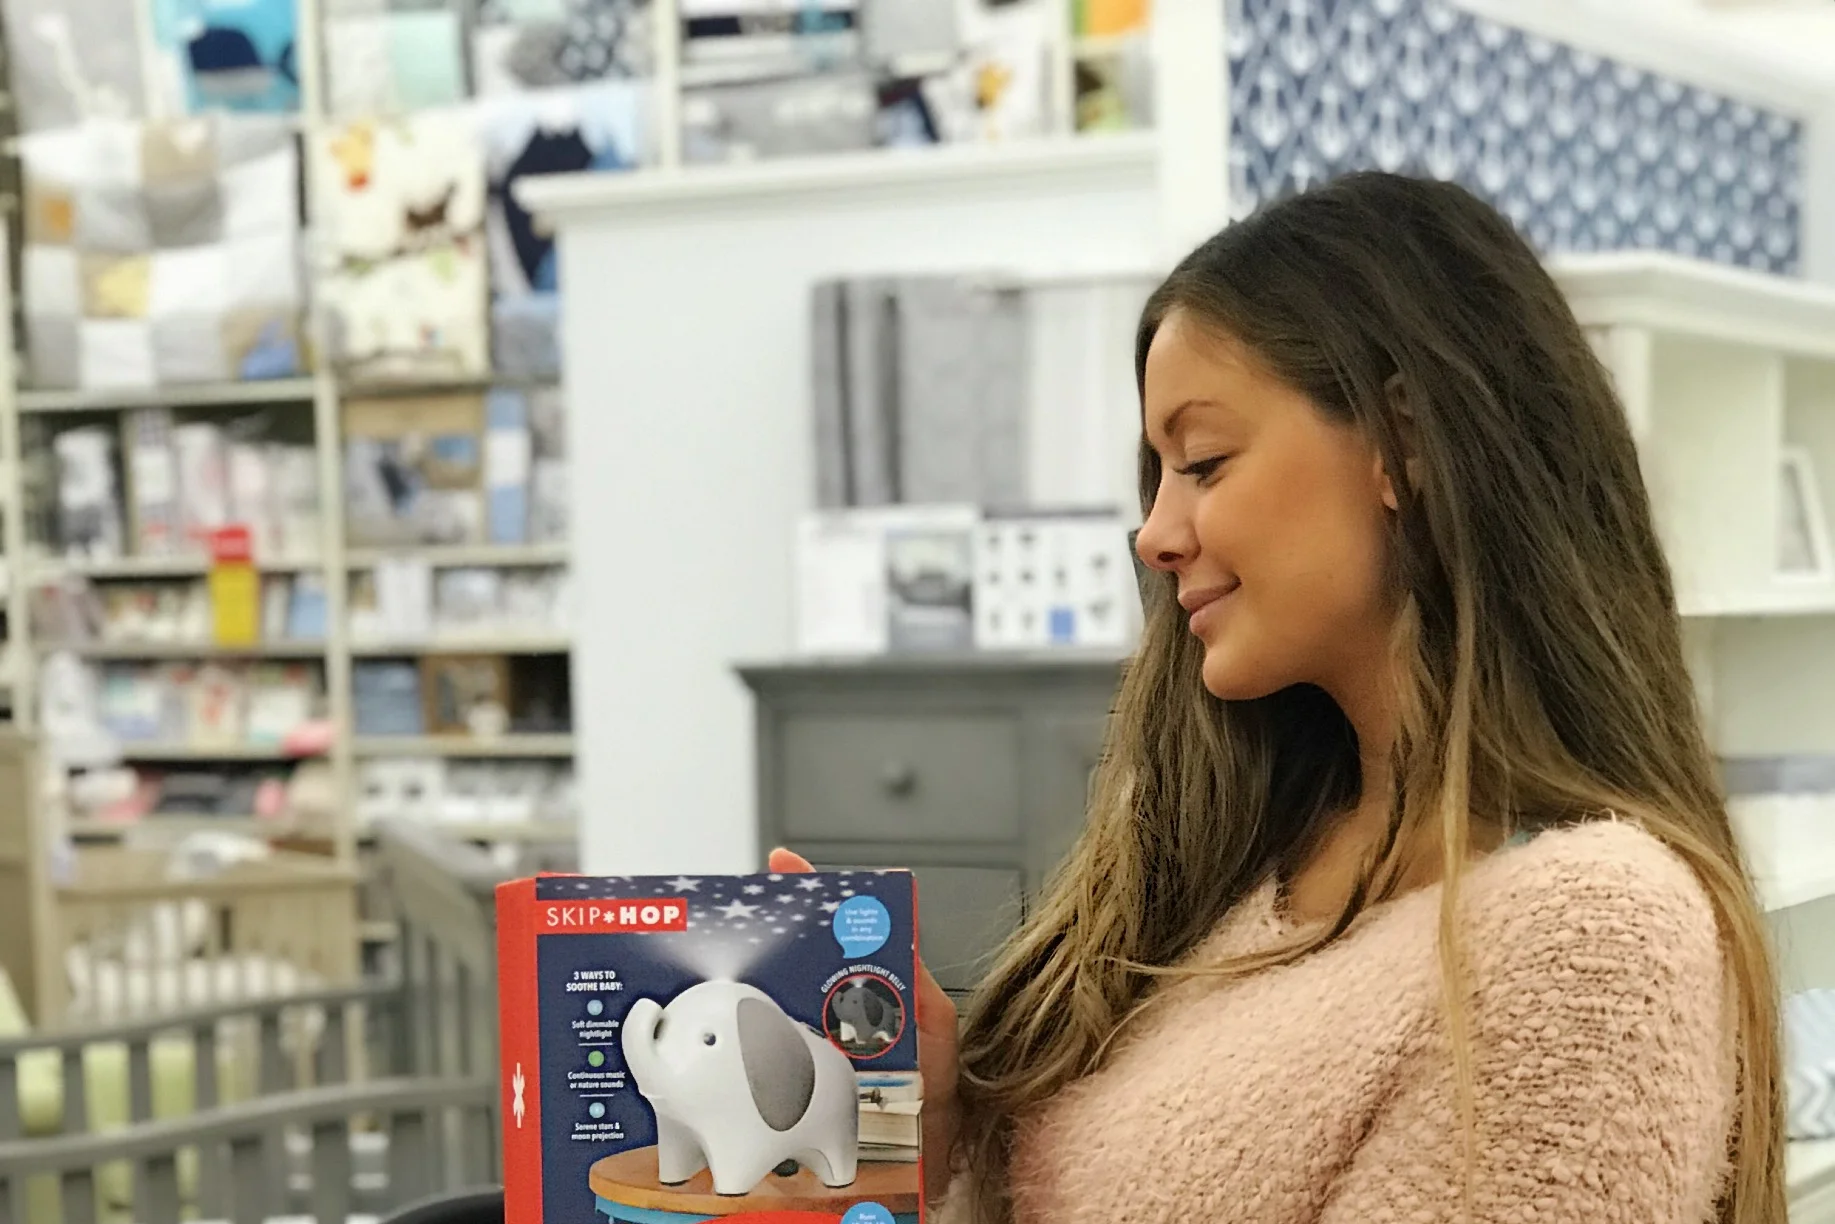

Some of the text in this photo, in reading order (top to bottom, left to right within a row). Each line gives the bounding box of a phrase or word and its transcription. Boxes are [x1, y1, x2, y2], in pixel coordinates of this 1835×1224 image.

[573, 970, 616, 980] 3 WAYS TO
[821, 964, 906, 993] GLOWING NIGHTLIGHT BELLY
[566, 982, 623, 992] SOOTHE BABY:
[571, 1019, 619, 1029] Soft dimmable
[579, 1030, 612, 1040] nightlight
[567, 1070, 625, 1080] Continuous music
[600, 1080, 624, 1088] sounds
[574, 1122, 598, 1131] Serene
[598, 1122, 614, 1130] stars
[591, 1132, 624, 1142] projection
